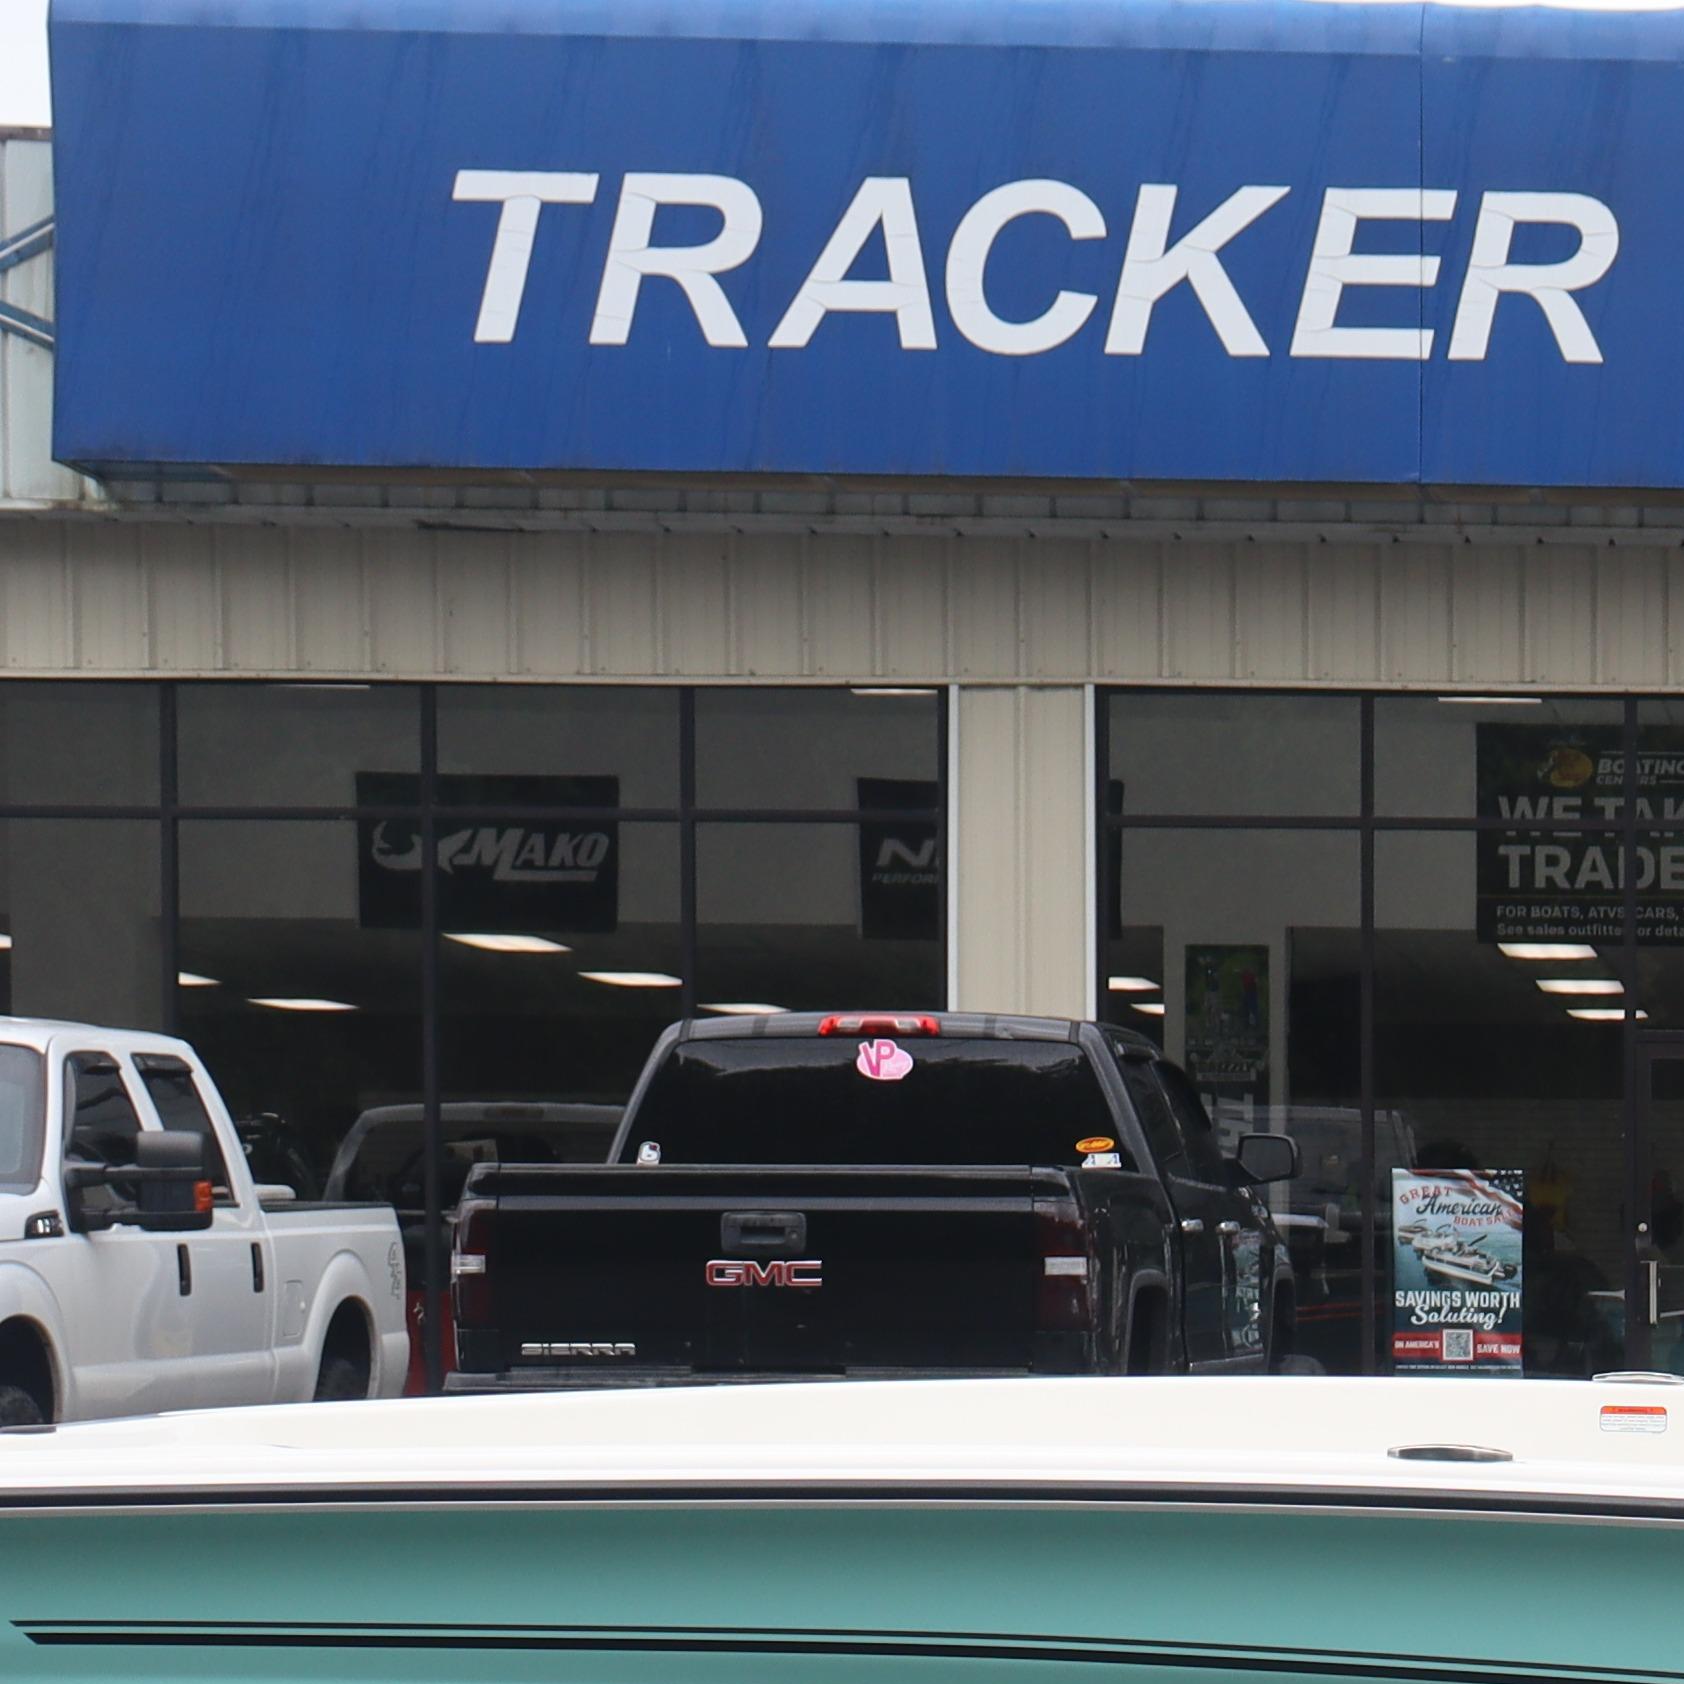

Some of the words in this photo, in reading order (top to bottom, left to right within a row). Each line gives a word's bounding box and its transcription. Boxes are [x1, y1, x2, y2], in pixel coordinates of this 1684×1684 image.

[453, 171, 1618, 362] TRACKER
[1498, 795, 1582, 837] WE
[452, 826, 610, 882] MAKO
[1496, 905, 1526, 918] FOR
[1531, 905, 1585, 920] BOATS,
[1588, 906, 1626, 919] ATVS
[1497, 924, 1523, 936] See
[1526, 924, 1565, 936] sales
[1568, 923, 1624, 936] outfitte
[859, 1039, 896, 1078] VP
[1399, 1184, 1453, 1205] GREAT
[1416, 1194, 1504, 1216] American
[1453, 1215, 1482, 1227] BOAT
[706, 1259, 823, 1287] GMC
[1395, 1290, 1462, 1308] SAVINGS
[1465, 1291, 1521, 1309] WORTH
[1410, 1300, 1507, 1331] Saluting!
[521, 1343, 636, 1356] SIERRA
[1476, 1343, 1499, 1355] SAVE
[1501, 1344, 1521, 1355] NOW
